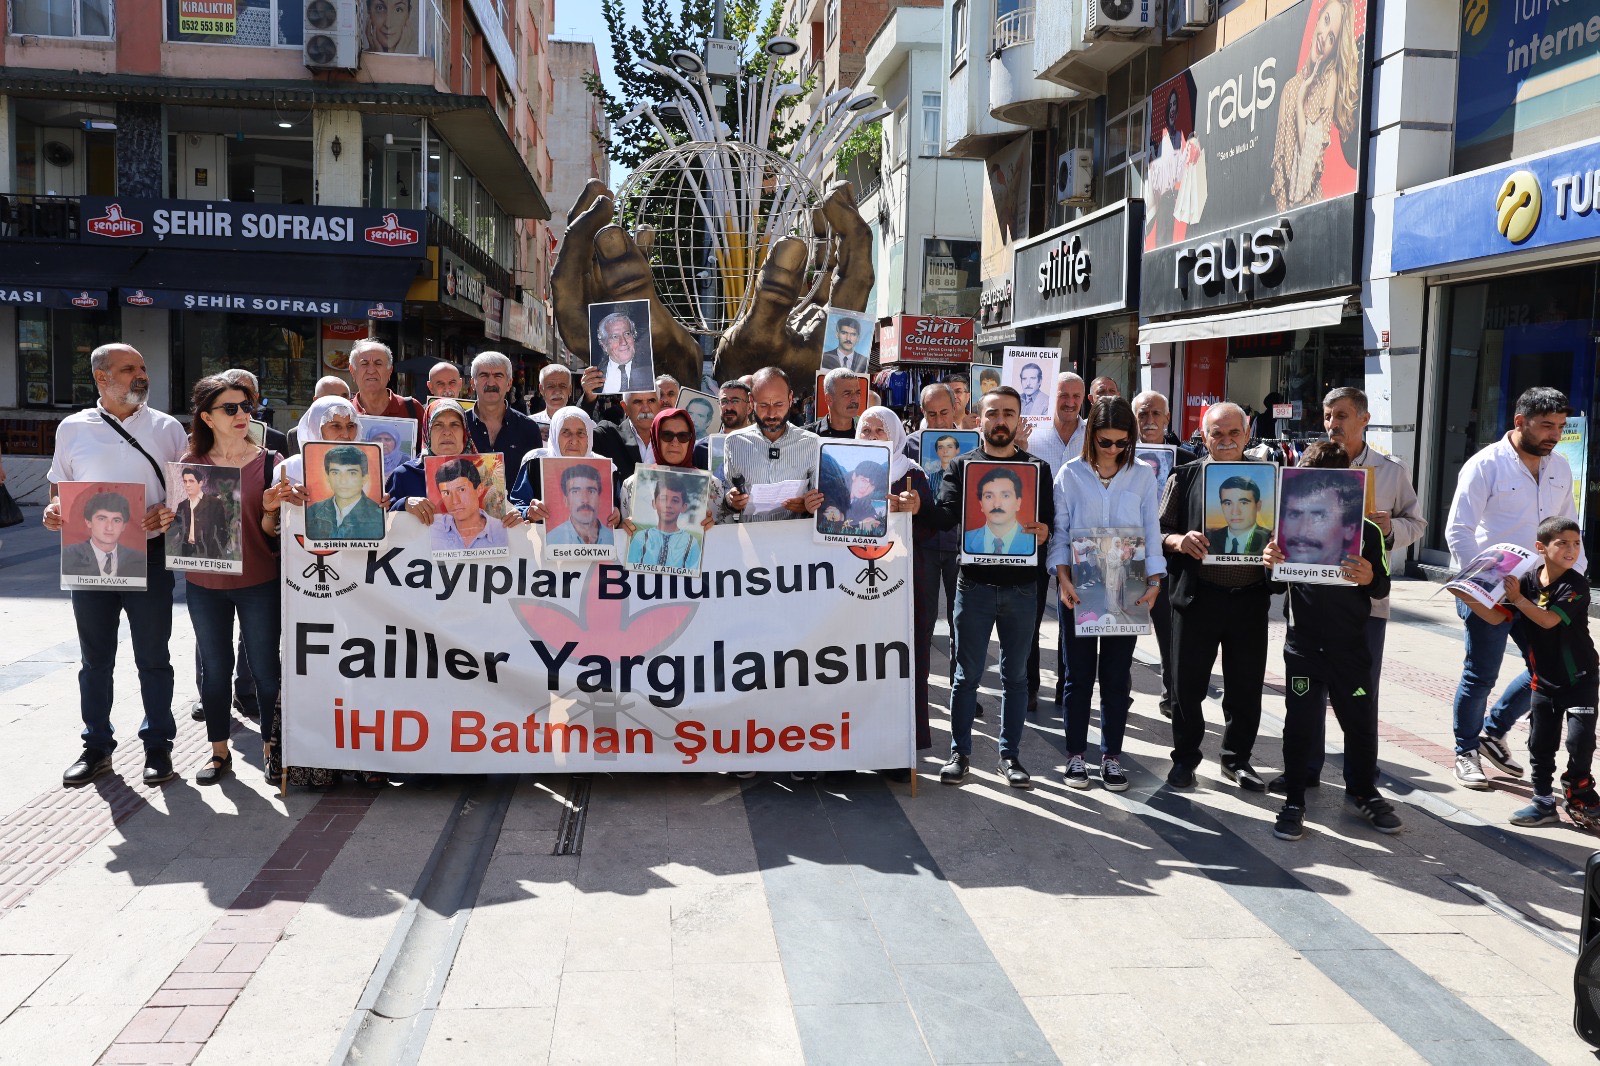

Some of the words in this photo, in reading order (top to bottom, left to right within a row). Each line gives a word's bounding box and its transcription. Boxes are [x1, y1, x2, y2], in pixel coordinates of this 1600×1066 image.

[182, 20, 198, 31] 0532
[200, 21, 213, 32] 553
[215, 22, 224, 32] 58
[226, 22, 234, 32] 85
[1206, 57, 1277, 135] rays
[93, 220, 136, 234] şenpiliç
[153, 204, 232, 241] ŞEHİR
[242, 213, 354, 242] SOFRASI
[370, 229, 412, 242] şenpiliç
[184, 294, 246, 309] ŞEHİR
[252, 298, 338, 314] SOFRASI
[915, 320, 960, 336] Şirin
[906, 334, 968, 346] Collection
[1008, 349, 1038, 358] İBRAHİM
[1040, 350, 1058, 359] ÇELİK
[314, 541, 348, 549] M.ŞİRİN
[553, 549, 572, 557] Eset
[574, 548, 610, 557] GÖKTAYI
[173, 558, 197, 567] Ahmet
[200, 559, 232, 570] YETİŞEN
[632, 563, 659, 572] VEYSEL
[660, 566, 694, 576] ATILGAN
[365, 546, 582, 604] Kayıplar
[598, 562, 834, 600] Bulunsun
[1279, 566, 1318, 577] Hüseyin
[1082, 626, 1118, 634] MERYEM
[1120, 625, 1146, 633] BULUT
[296, 622, 510, 684] Failler
[529, 640, 910, 708] Yargılansın
[334, 698, 429, 752] İHD
[450, 710, 654, 754] Batman
[674, 711, 850, 764] Şubesi
